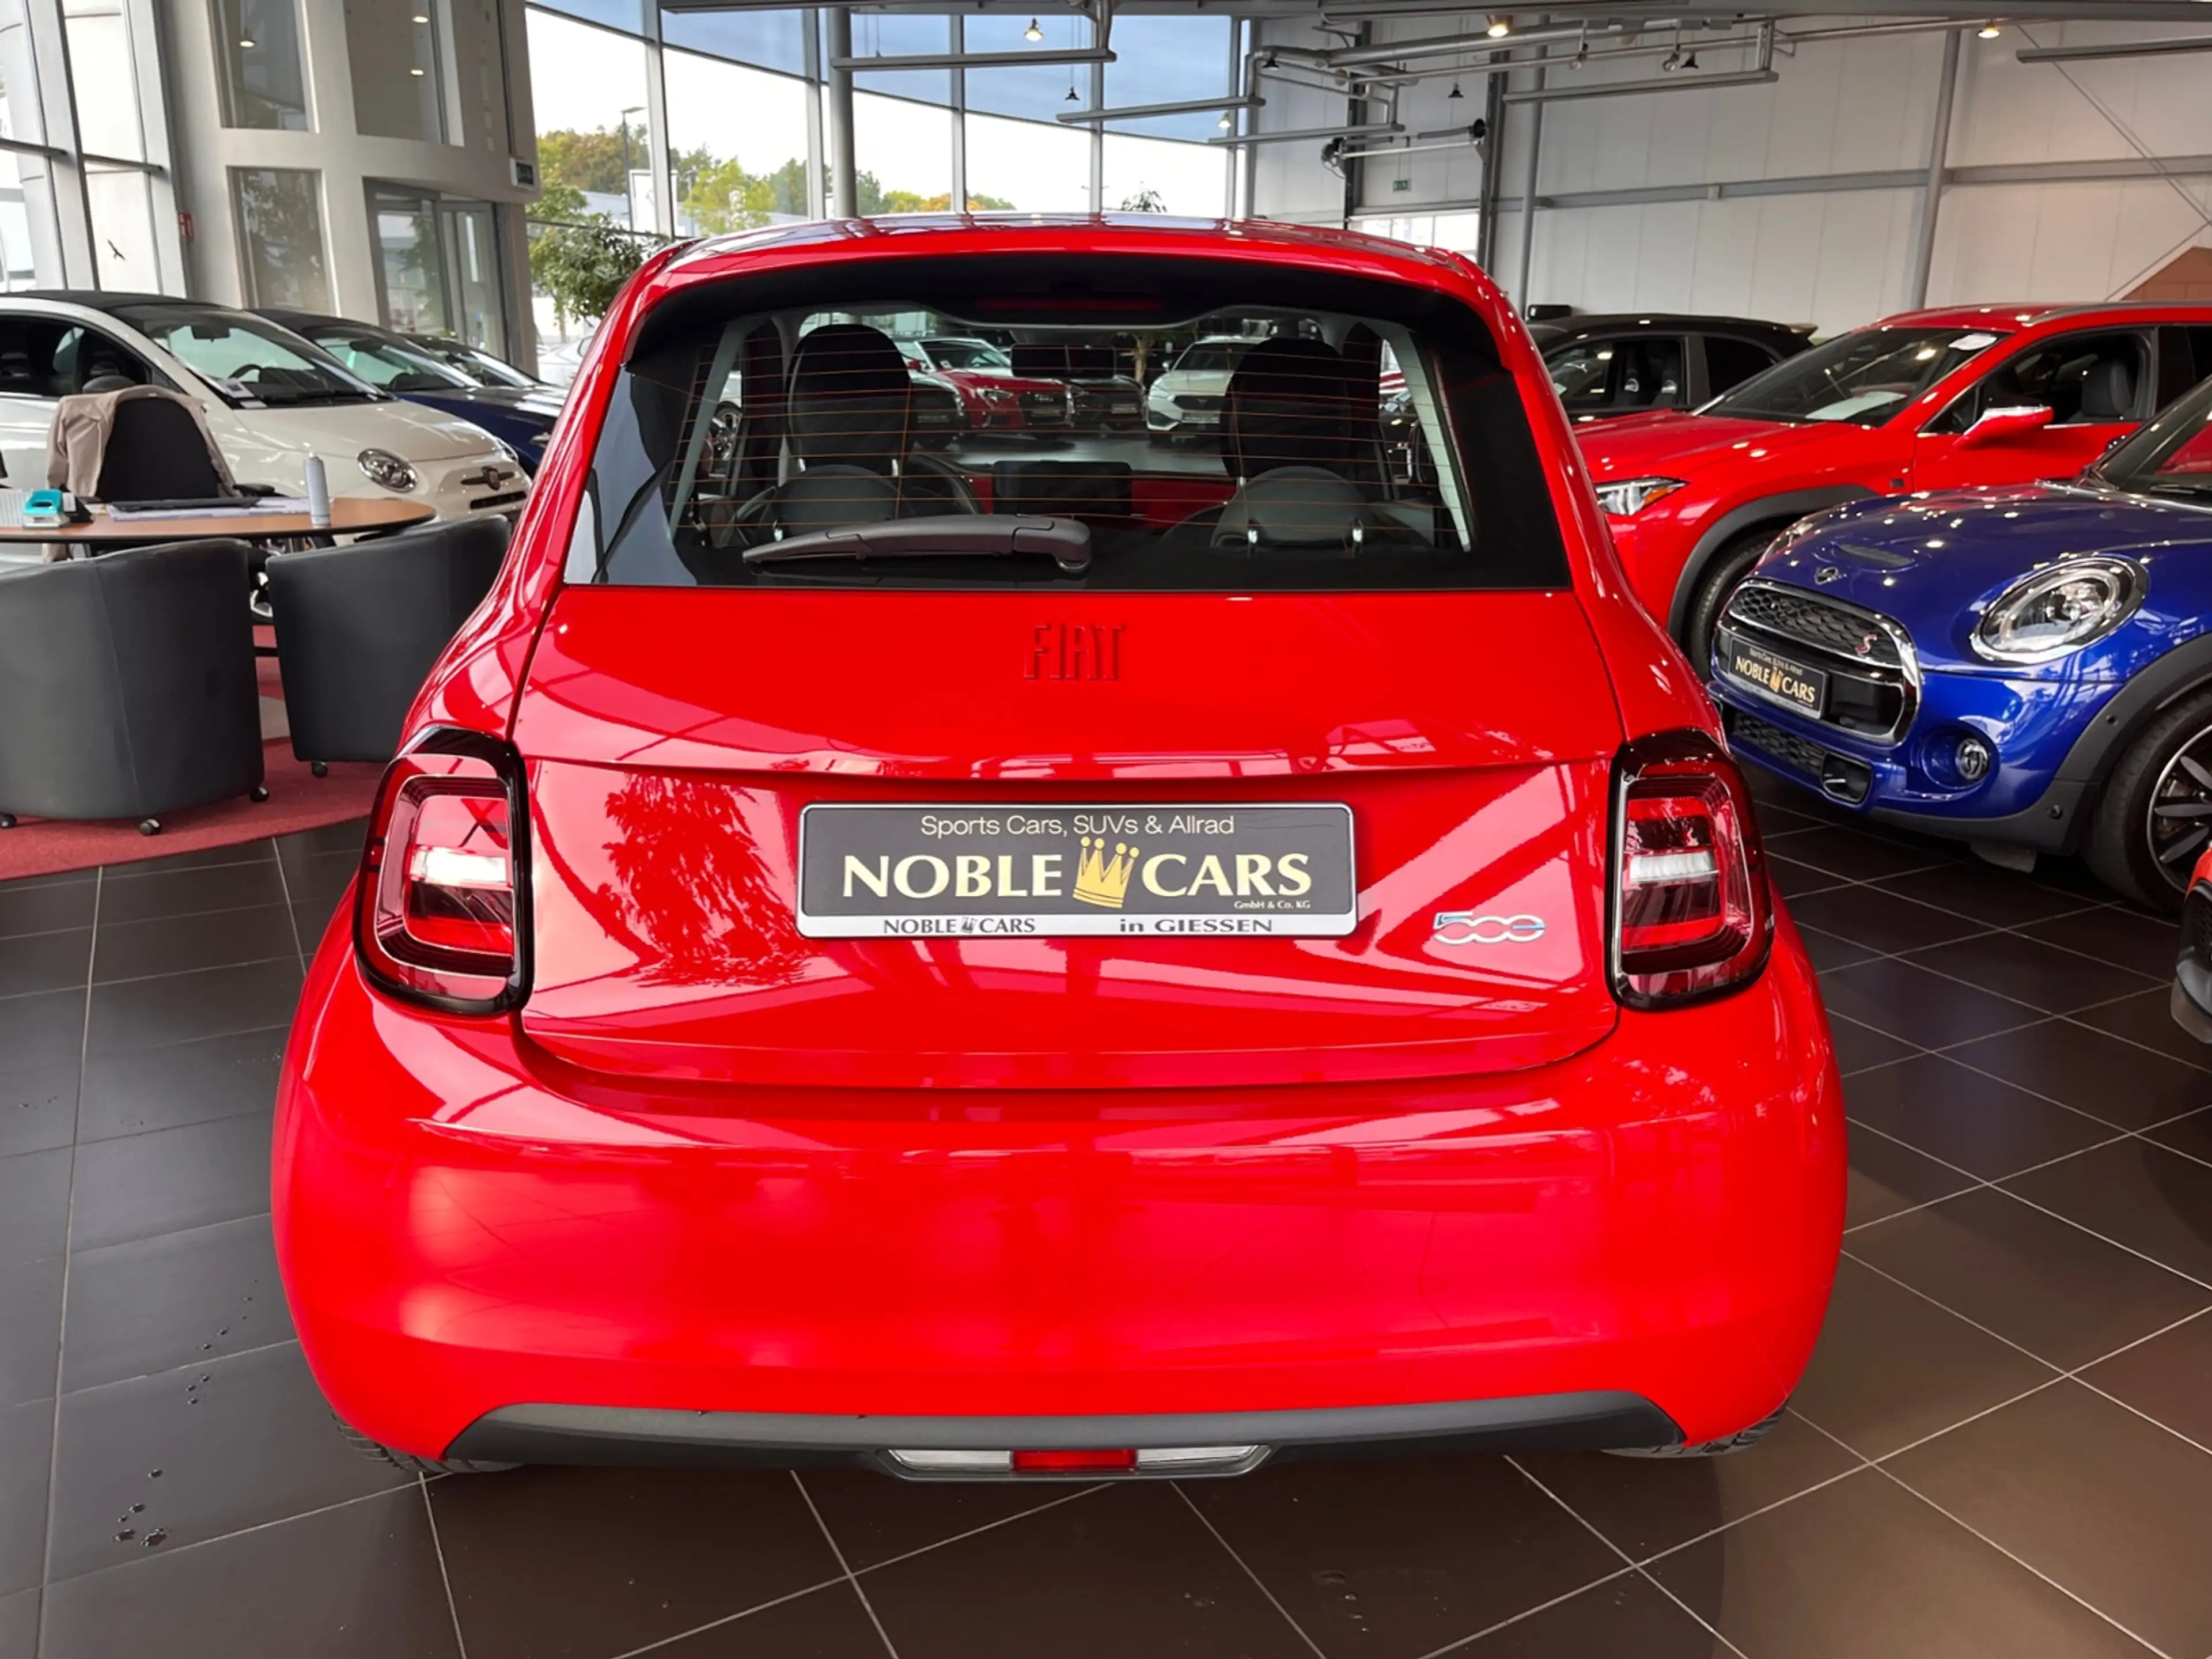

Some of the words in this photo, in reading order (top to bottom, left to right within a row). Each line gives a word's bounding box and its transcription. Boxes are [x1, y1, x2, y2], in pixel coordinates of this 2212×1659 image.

[1024, 624, 1126, 680] FIAT
[1735, 656, 1770, 684] NOBLE
[1782, 676, 1815, 703] CARS
[921, 815, 1000, 839] Sports
[1007, 815, 1067, 837] Cars,
[1074, 815, 1139, 834] SUVs
[1145, 815, 1162, 834] &
[1169, 815, 1234, 834] Allrad
[843, 854, 1062, 898] NOBLE
[1142, 853, 1312, 896] CARS
[1234, 900, 1265, 909] GmbH
[1267, 900, 1275, 909] &
[1277, 900, 1294, 909] Co.
[1296, 900, 1311, 909] KG
[884, 919, 956, 934] NOBLE
[979, 918, 1036, 933] CARS
[1120, 919, 1144, 933] in
[1155, 919, 1272, 933] GIESSEN
